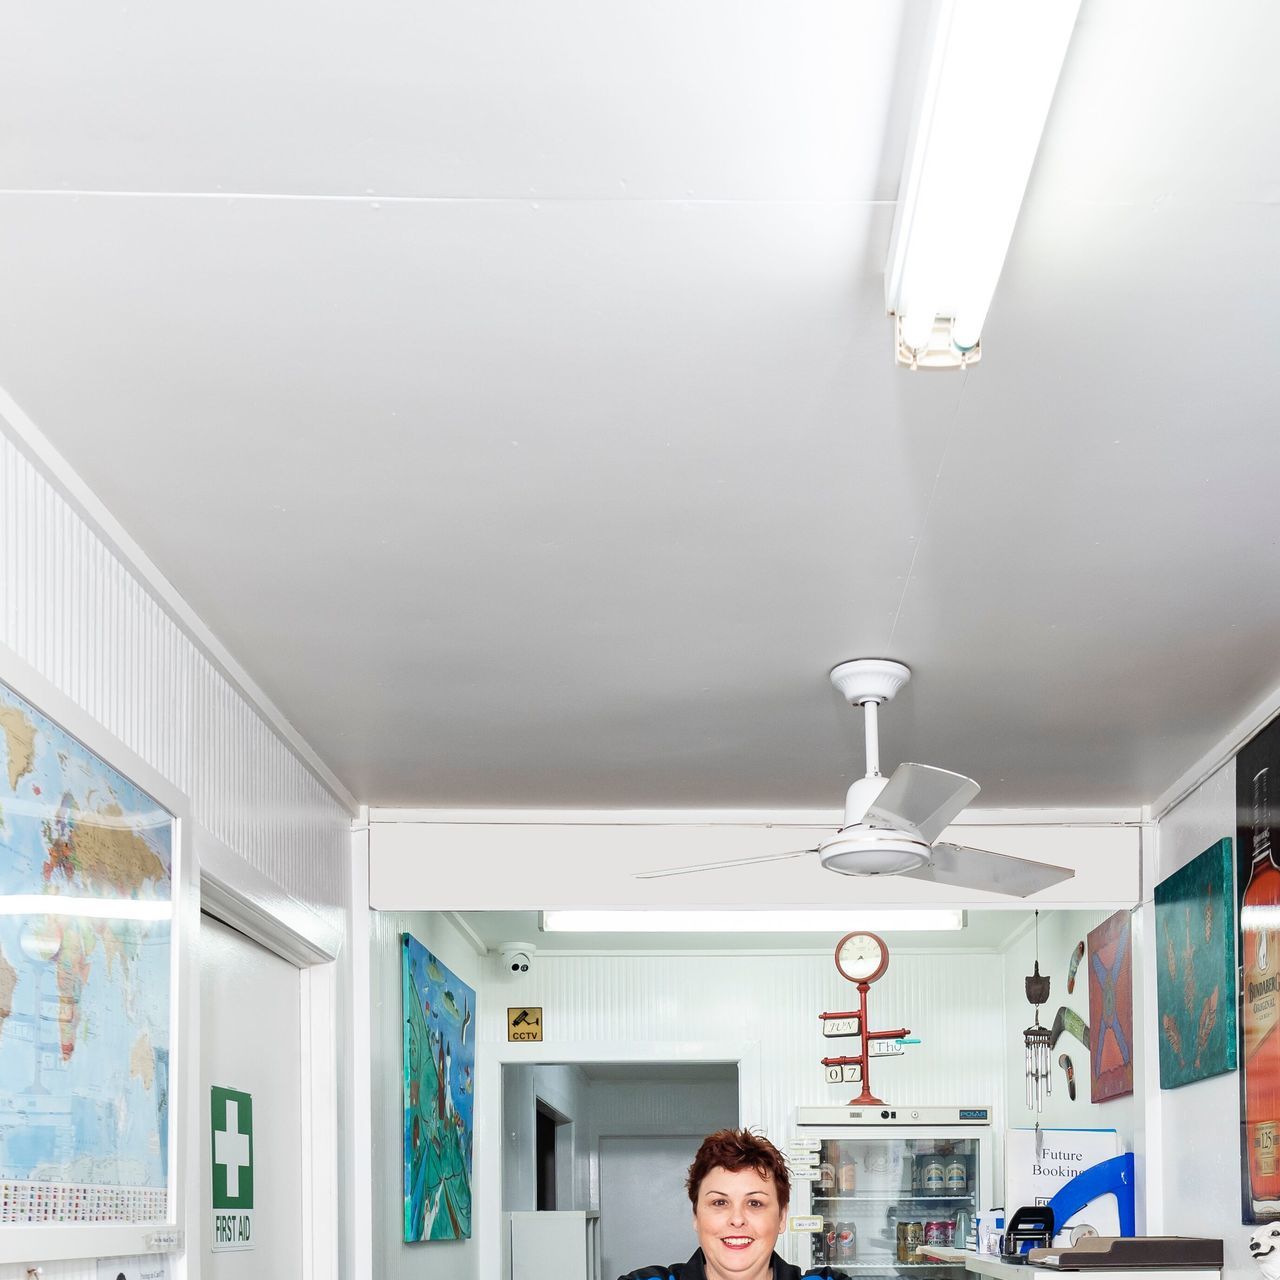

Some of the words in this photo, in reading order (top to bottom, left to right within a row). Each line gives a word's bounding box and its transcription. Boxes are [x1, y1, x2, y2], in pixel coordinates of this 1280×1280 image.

[828, 1019, 855, 1033] JUN
[512, 1031, 539, 1041] CCTV
[1042, 1148, 1084, 1162] Future
[215, 1214, 237, 1243] FIRST
[237, 1214, 251, 1242] AID
